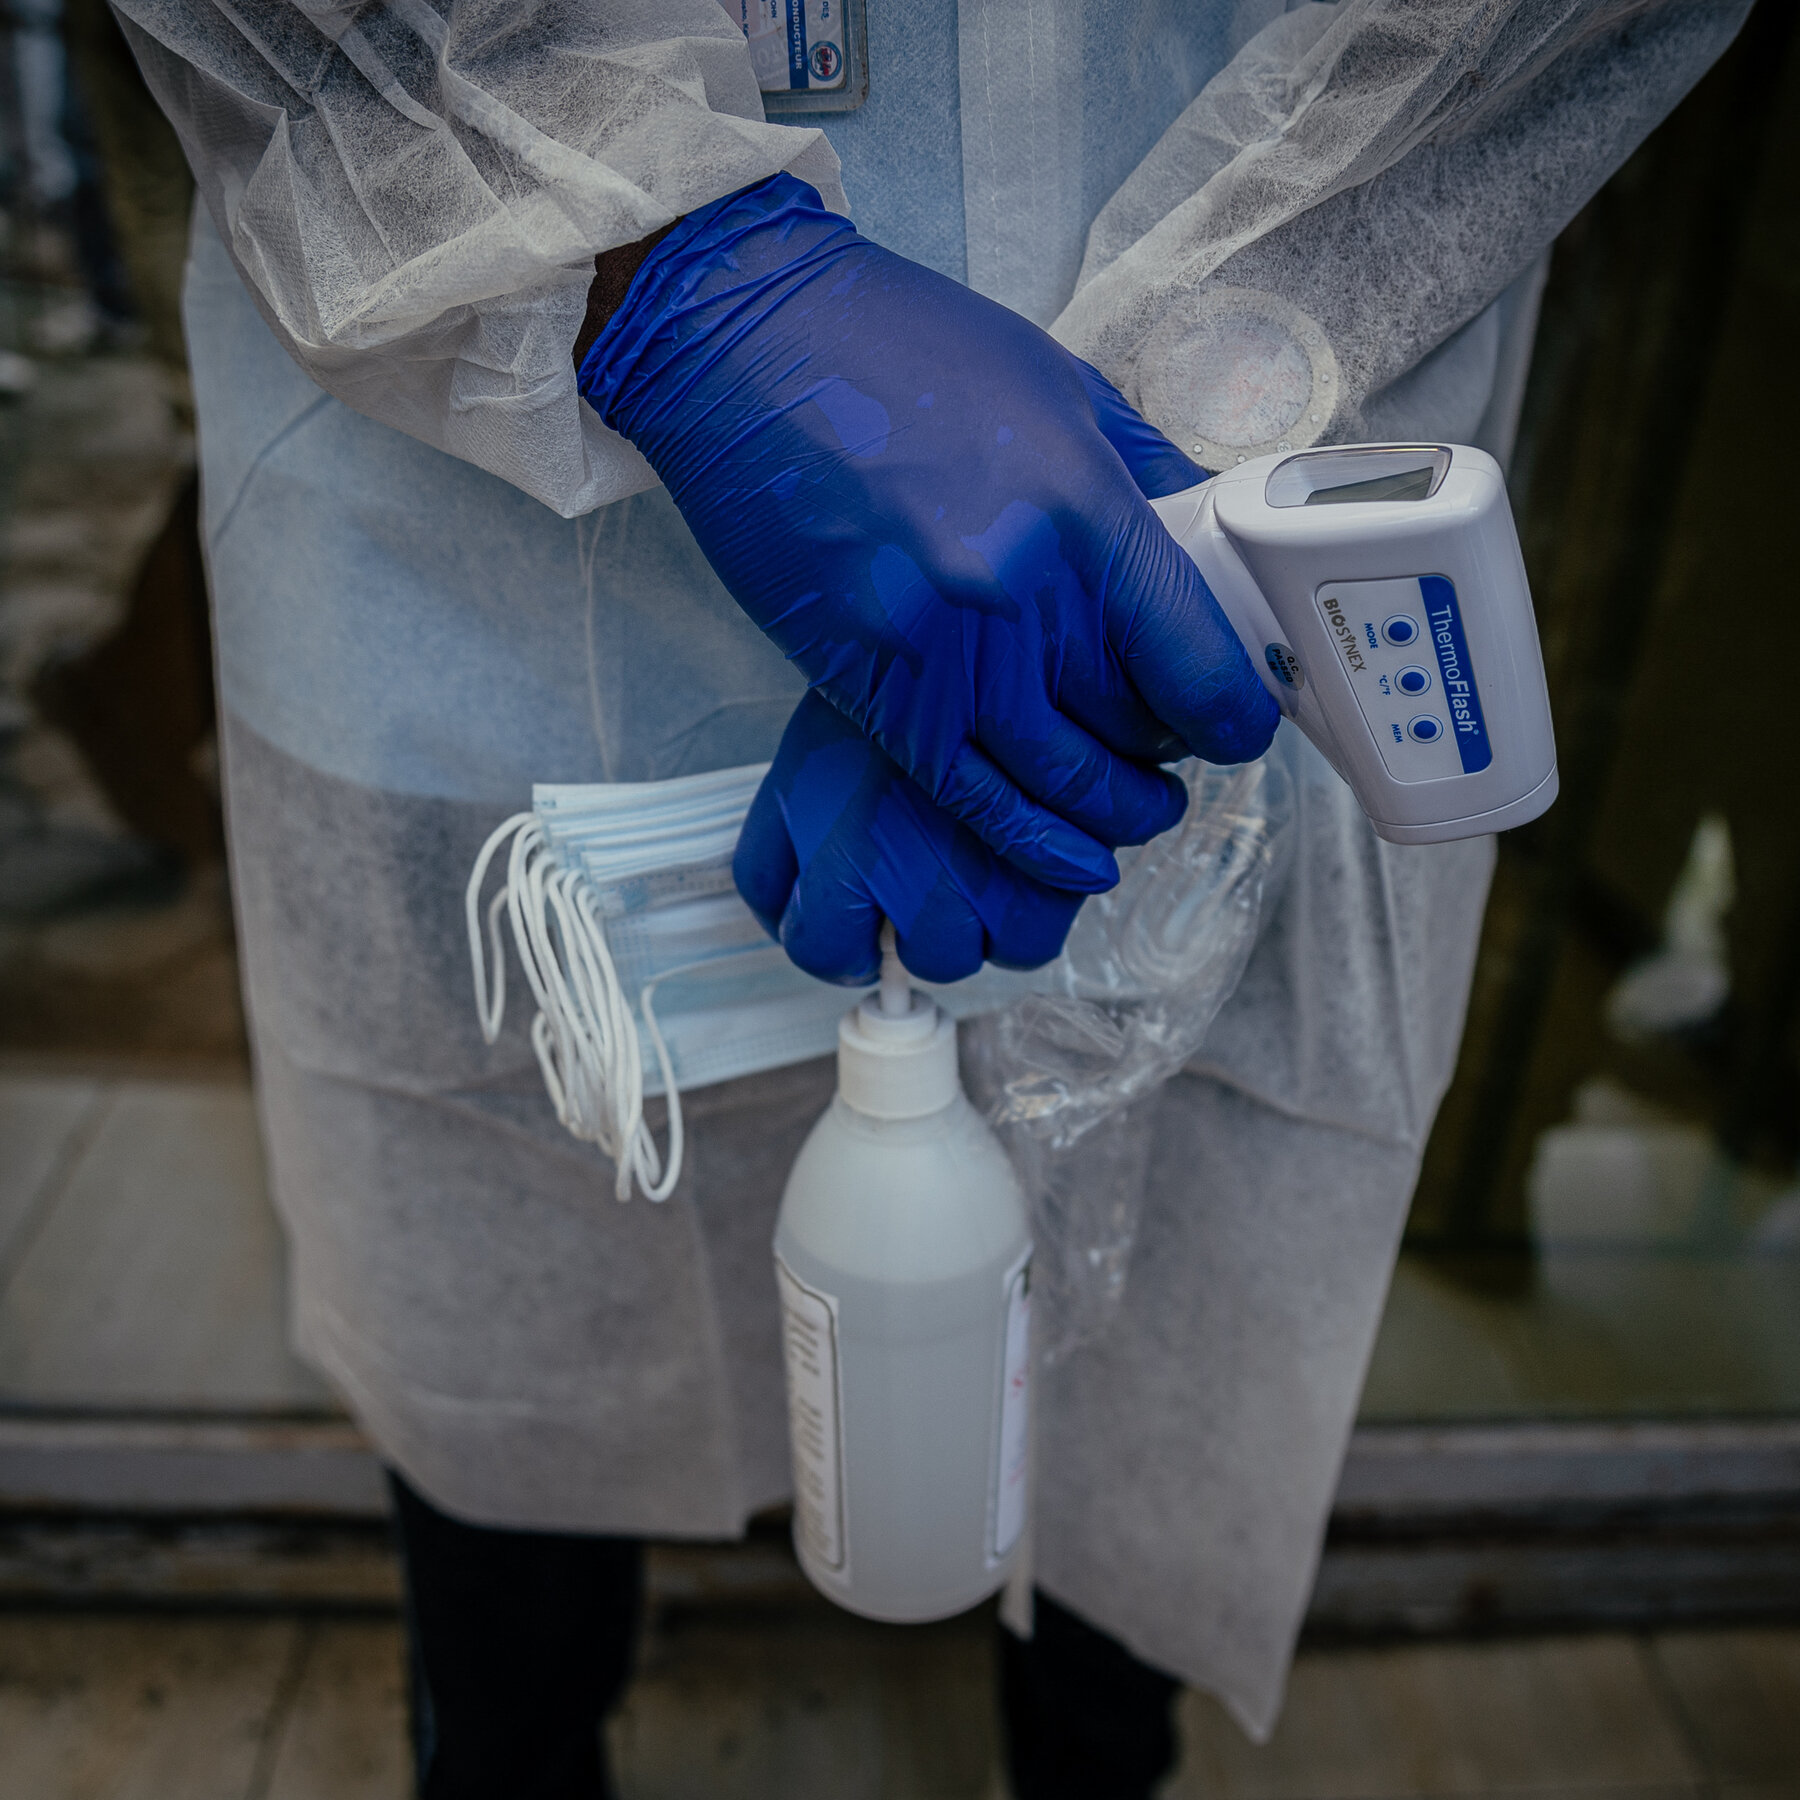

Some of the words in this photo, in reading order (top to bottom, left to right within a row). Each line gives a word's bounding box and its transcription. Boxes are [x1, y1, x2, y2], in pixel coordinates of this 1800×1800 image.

[792, 0, 803, 70] ONDUCTEUR
[1323, 598, 1367, 673] BIOSYNEX
[1364, 622, 1378, 649] MODE
[1272, 649, 1294, 683] PASSED
[1287, 656, 1299, 675] Q.C.
[1431, 604, 1477, 733] ThermoFlash
[1391, 723, 1403, 743] MEM
